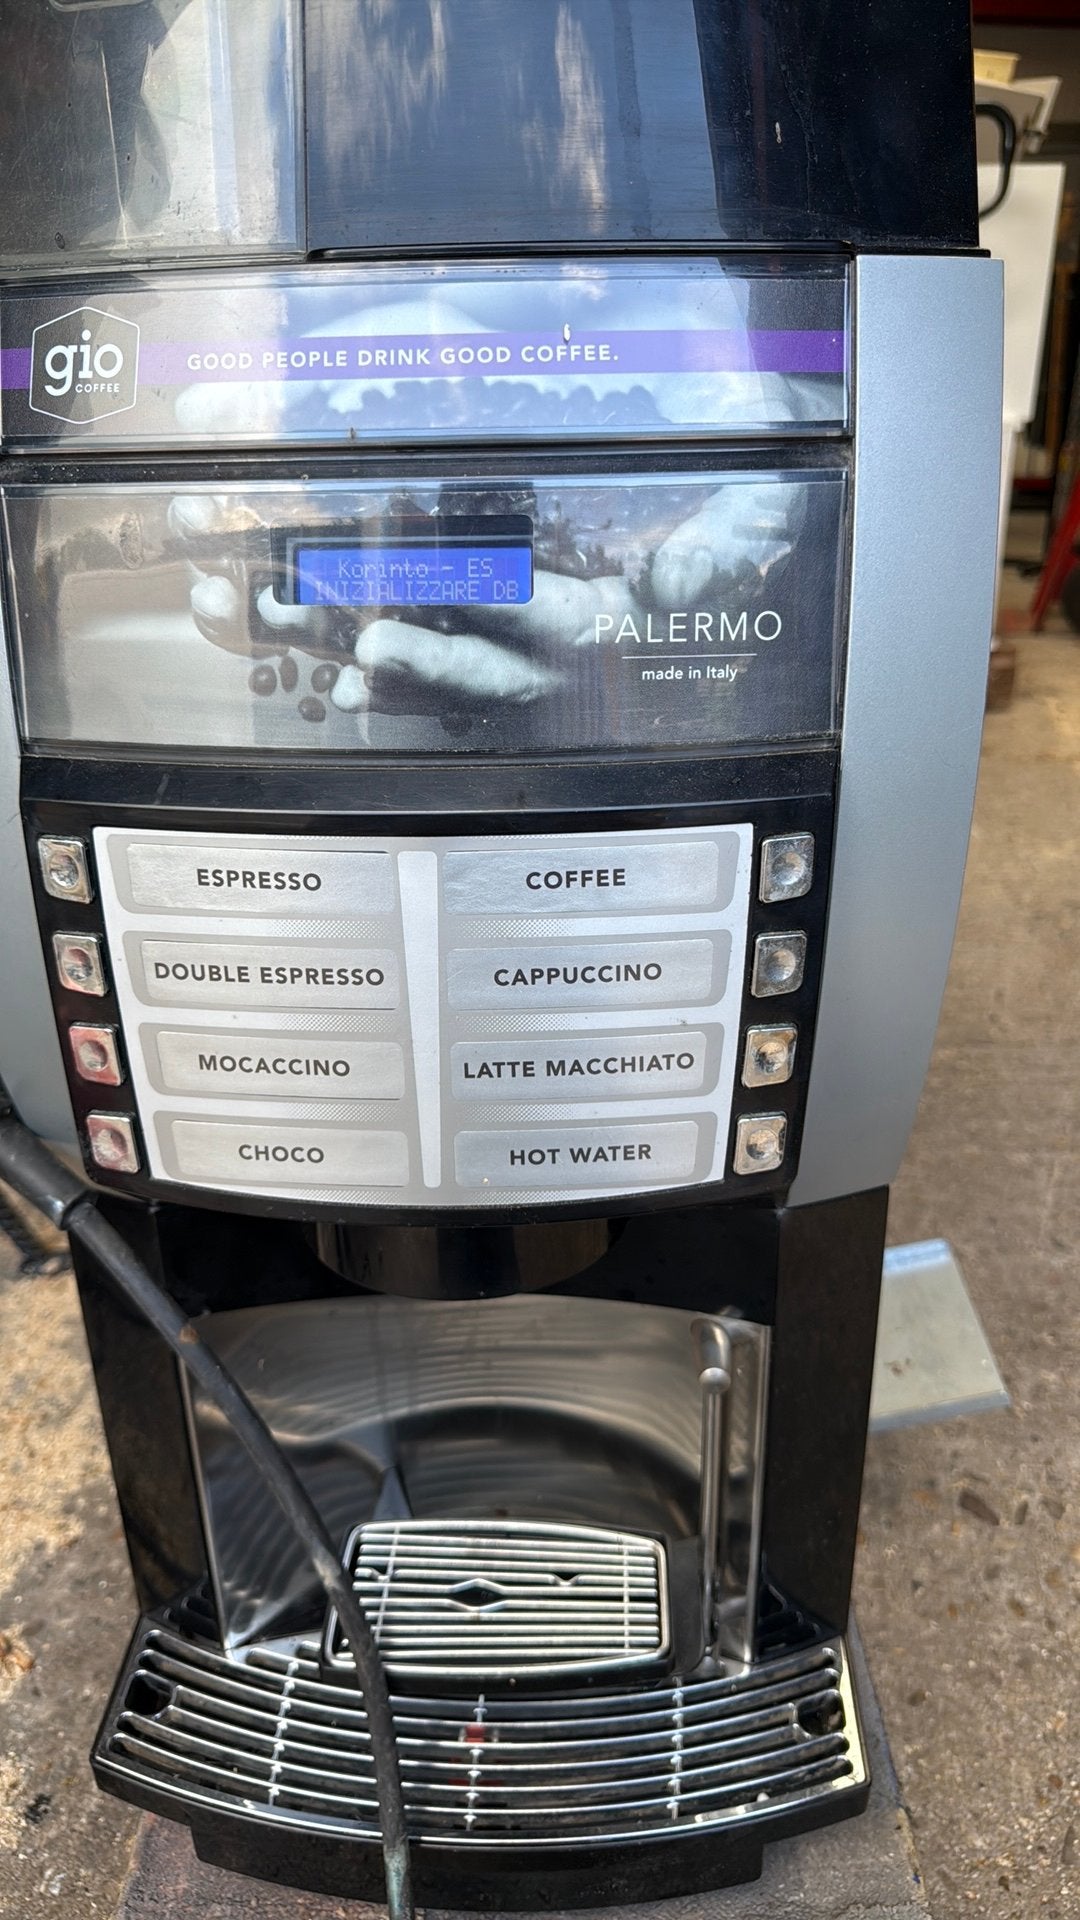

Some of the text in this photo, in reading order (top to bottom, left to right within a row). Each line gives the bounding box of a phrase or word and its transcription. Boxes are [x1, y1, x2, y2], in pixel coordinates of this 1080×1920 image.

[45, 330, 123, 397] gio
[187, 343, 620, 372] GOOD PEOPLE DRINK GOOD COFFEE.
[75, 383, 120, 395] COFFEE
[338, 558, 429, 579] Korinto
[468, 558, 494, 578] ES
[315, 580, 519, 601] INIZIALIZZARE DB
[594, 610, 783, 644] PALERMO
[641, 665, 738, 682] made in Italy
[197, 868, 322, 892] ESPRESSO
[526, 868, 626, 890] COFFEE
[154, 962, 385, 986] DOUBLE ESPRESSO
[493, 962, 663, 986] CAPPUCCINO
[198, 1054, 350, 1077] MOCACCINO
[463, 1052, 695, 1079] LATTE MACCHIATO
[238, 1144, 325, 1164] CHOCO
[509, 1143, 652, 1166] HOT WATER
